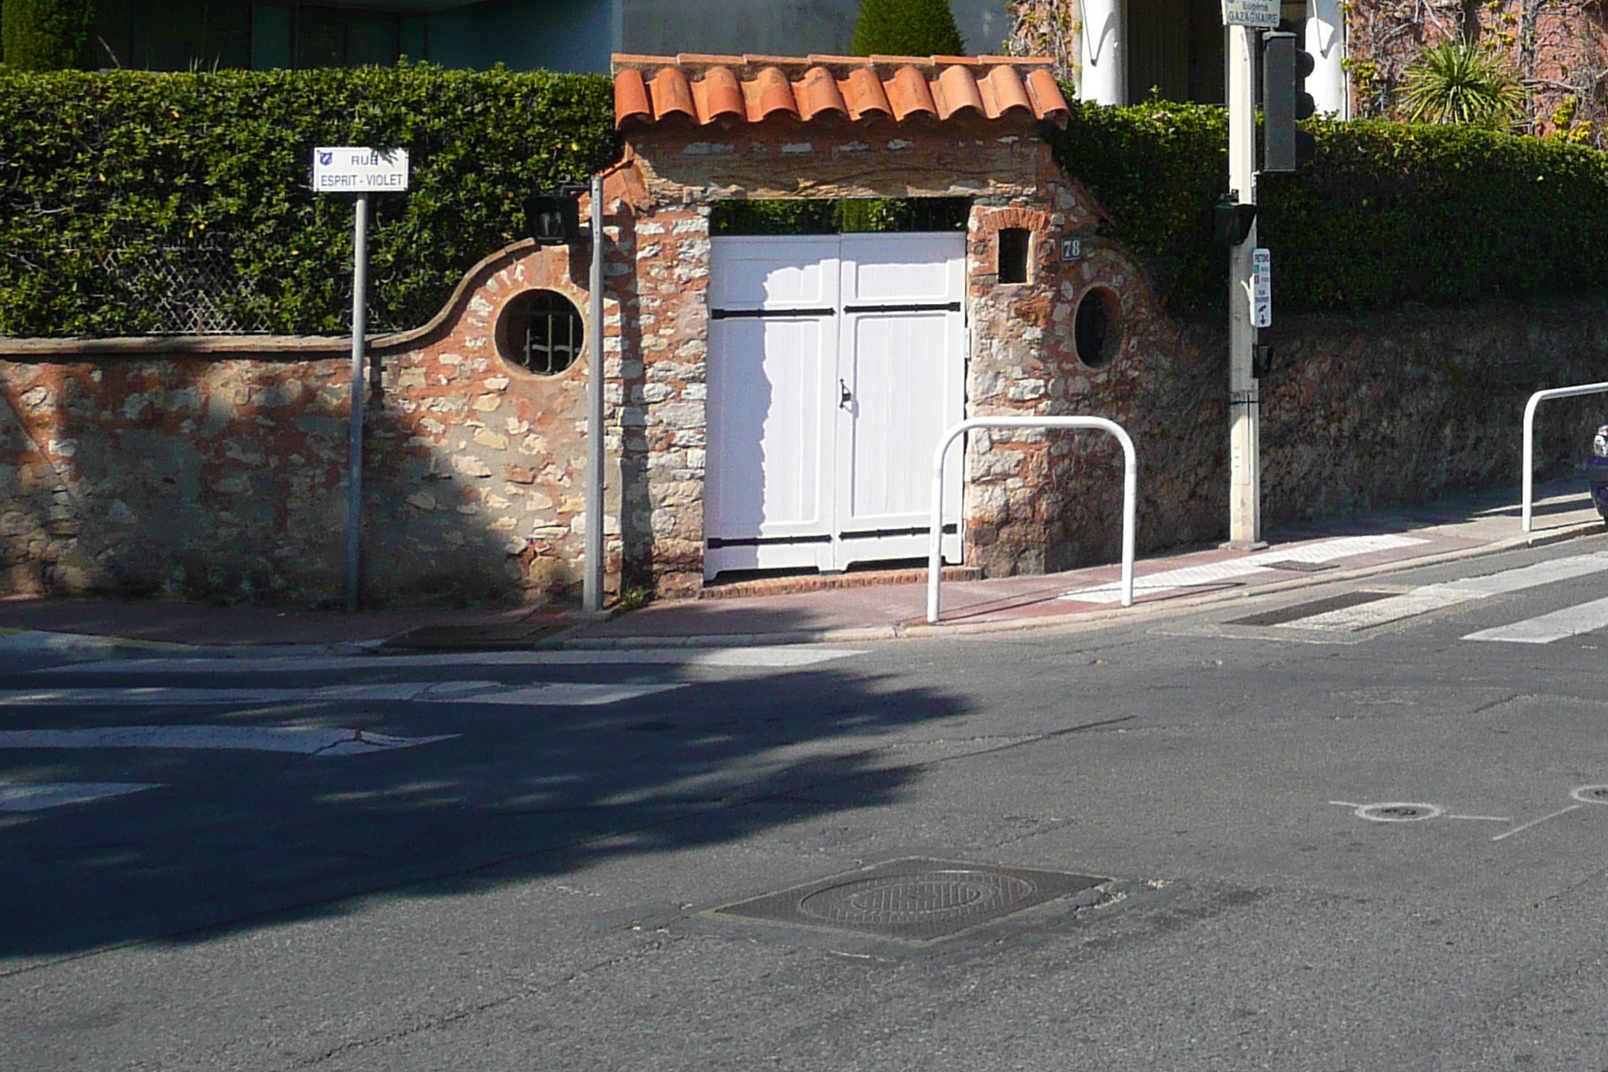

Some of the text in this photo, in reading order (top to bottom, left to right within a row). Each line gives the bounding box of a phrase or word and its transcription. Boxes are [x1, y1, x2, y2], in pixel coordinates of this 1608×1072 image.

[351, 155, 378, 165] RUE
[321, 174, 357, 187] ESPRIT
[366, 174, 402, 186] VIOLET
[1063, 240, 1080, 257] 78
